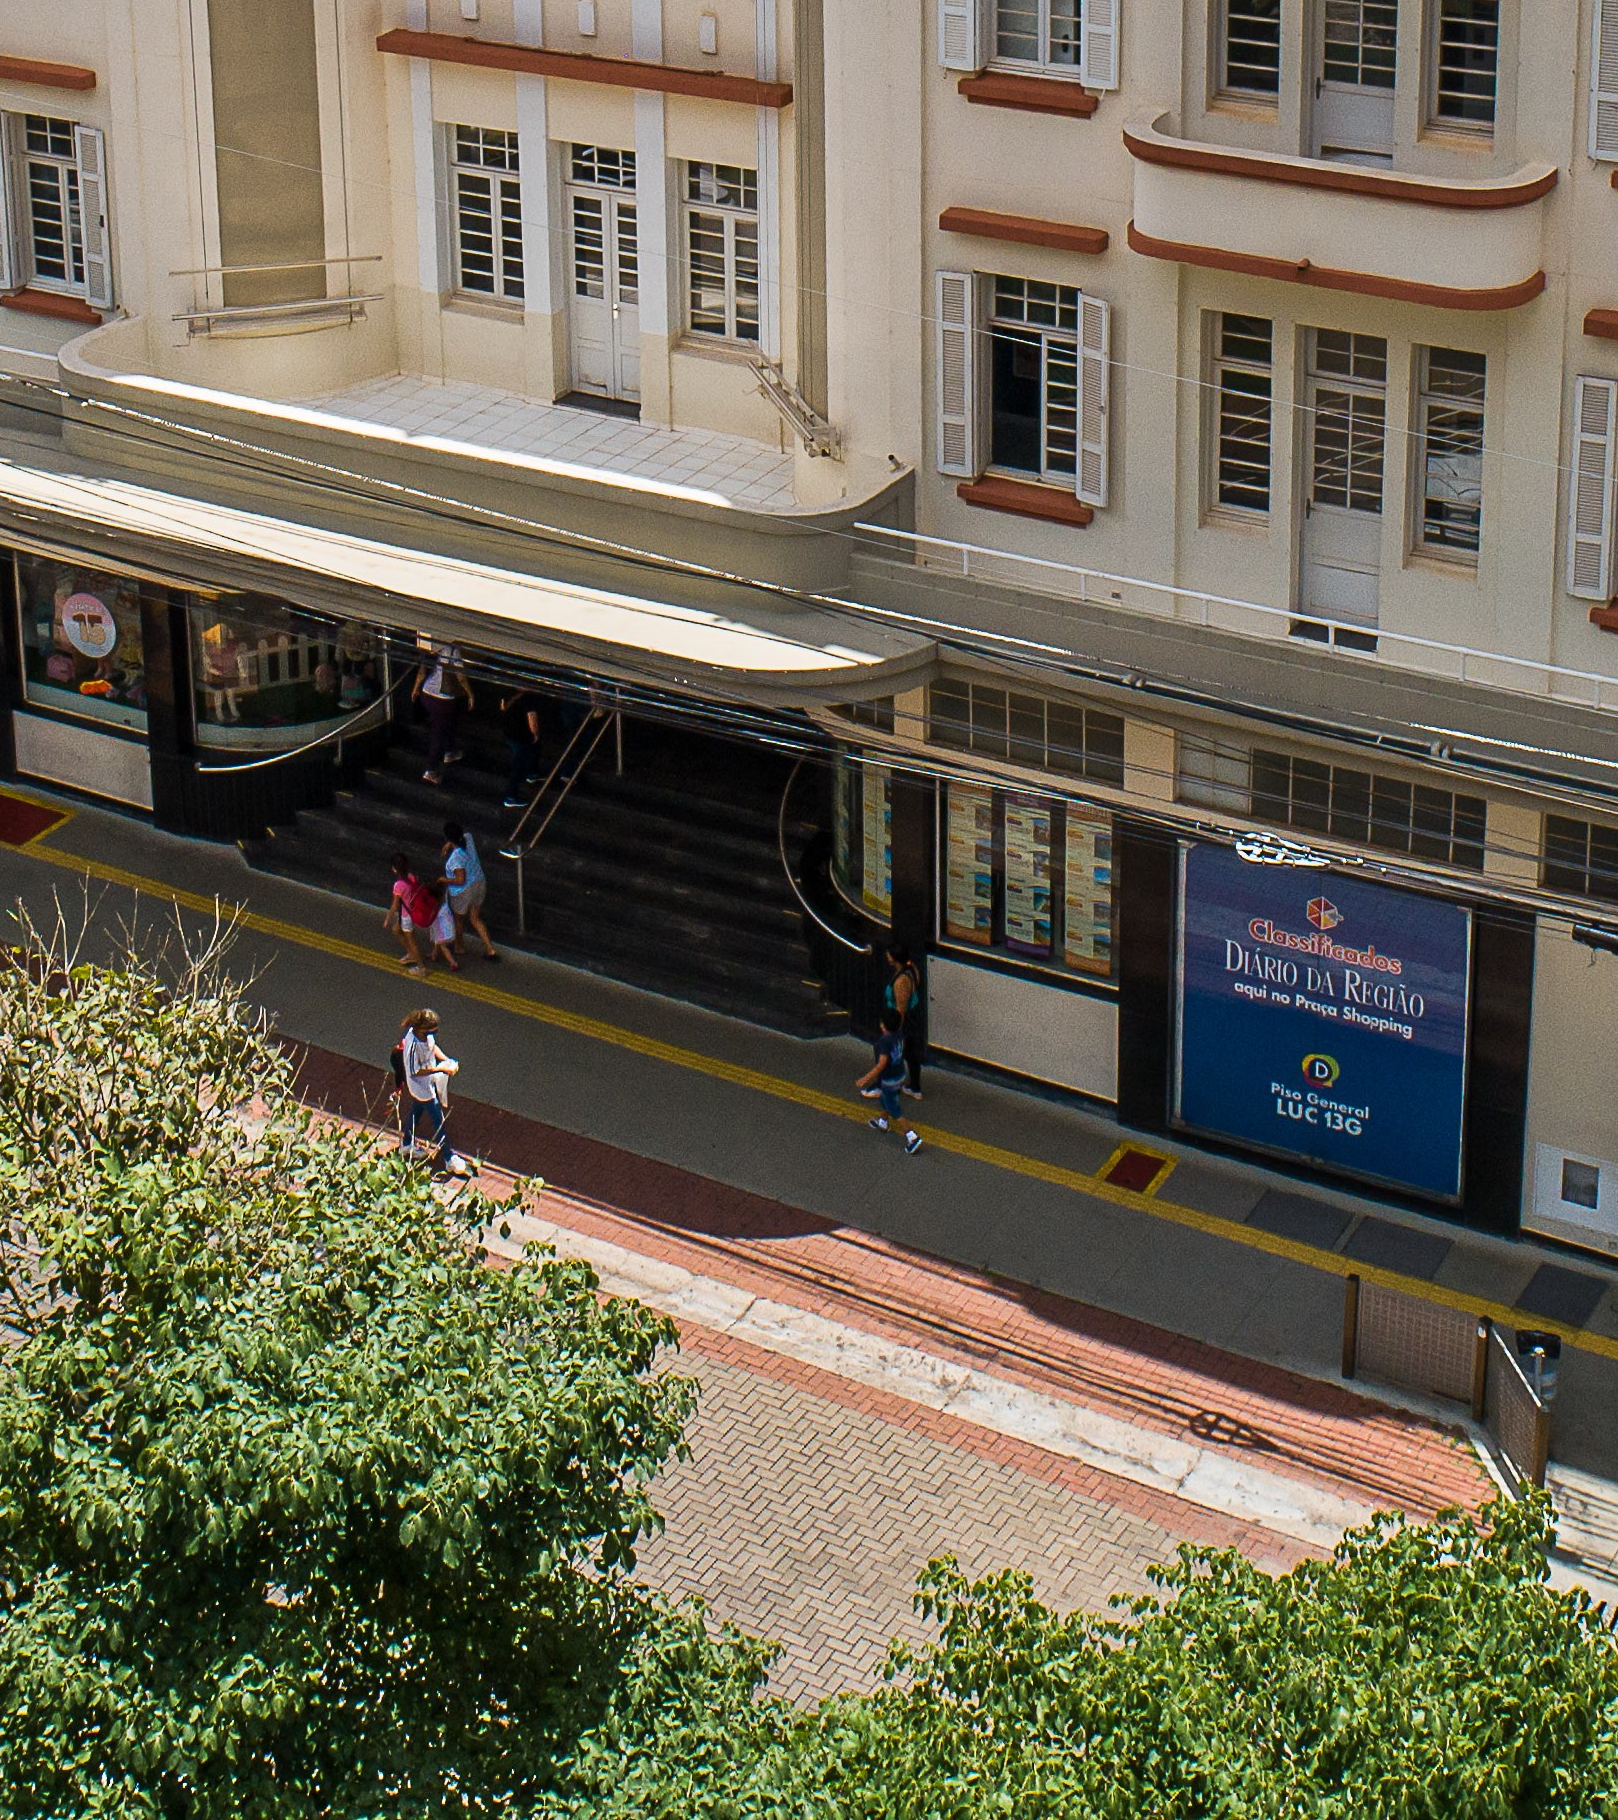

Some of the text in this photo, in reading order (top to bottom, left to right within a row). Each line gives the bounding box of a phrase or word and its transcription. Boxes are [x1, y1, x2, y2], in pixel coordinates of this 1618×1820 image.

[1248, 917, 1402, 975] Classificados
[1225, 939, 1425, 1018] DIÁRIO DA REGIÃO
[1234, 981, 1413, 1040] aqui no Praça Shopping
[1314, 1061, 1329, 1079] D
[1271, 1081, 1370, 1119] Piso General
[1276, 1098, 1363, 1136] LUC 13G
